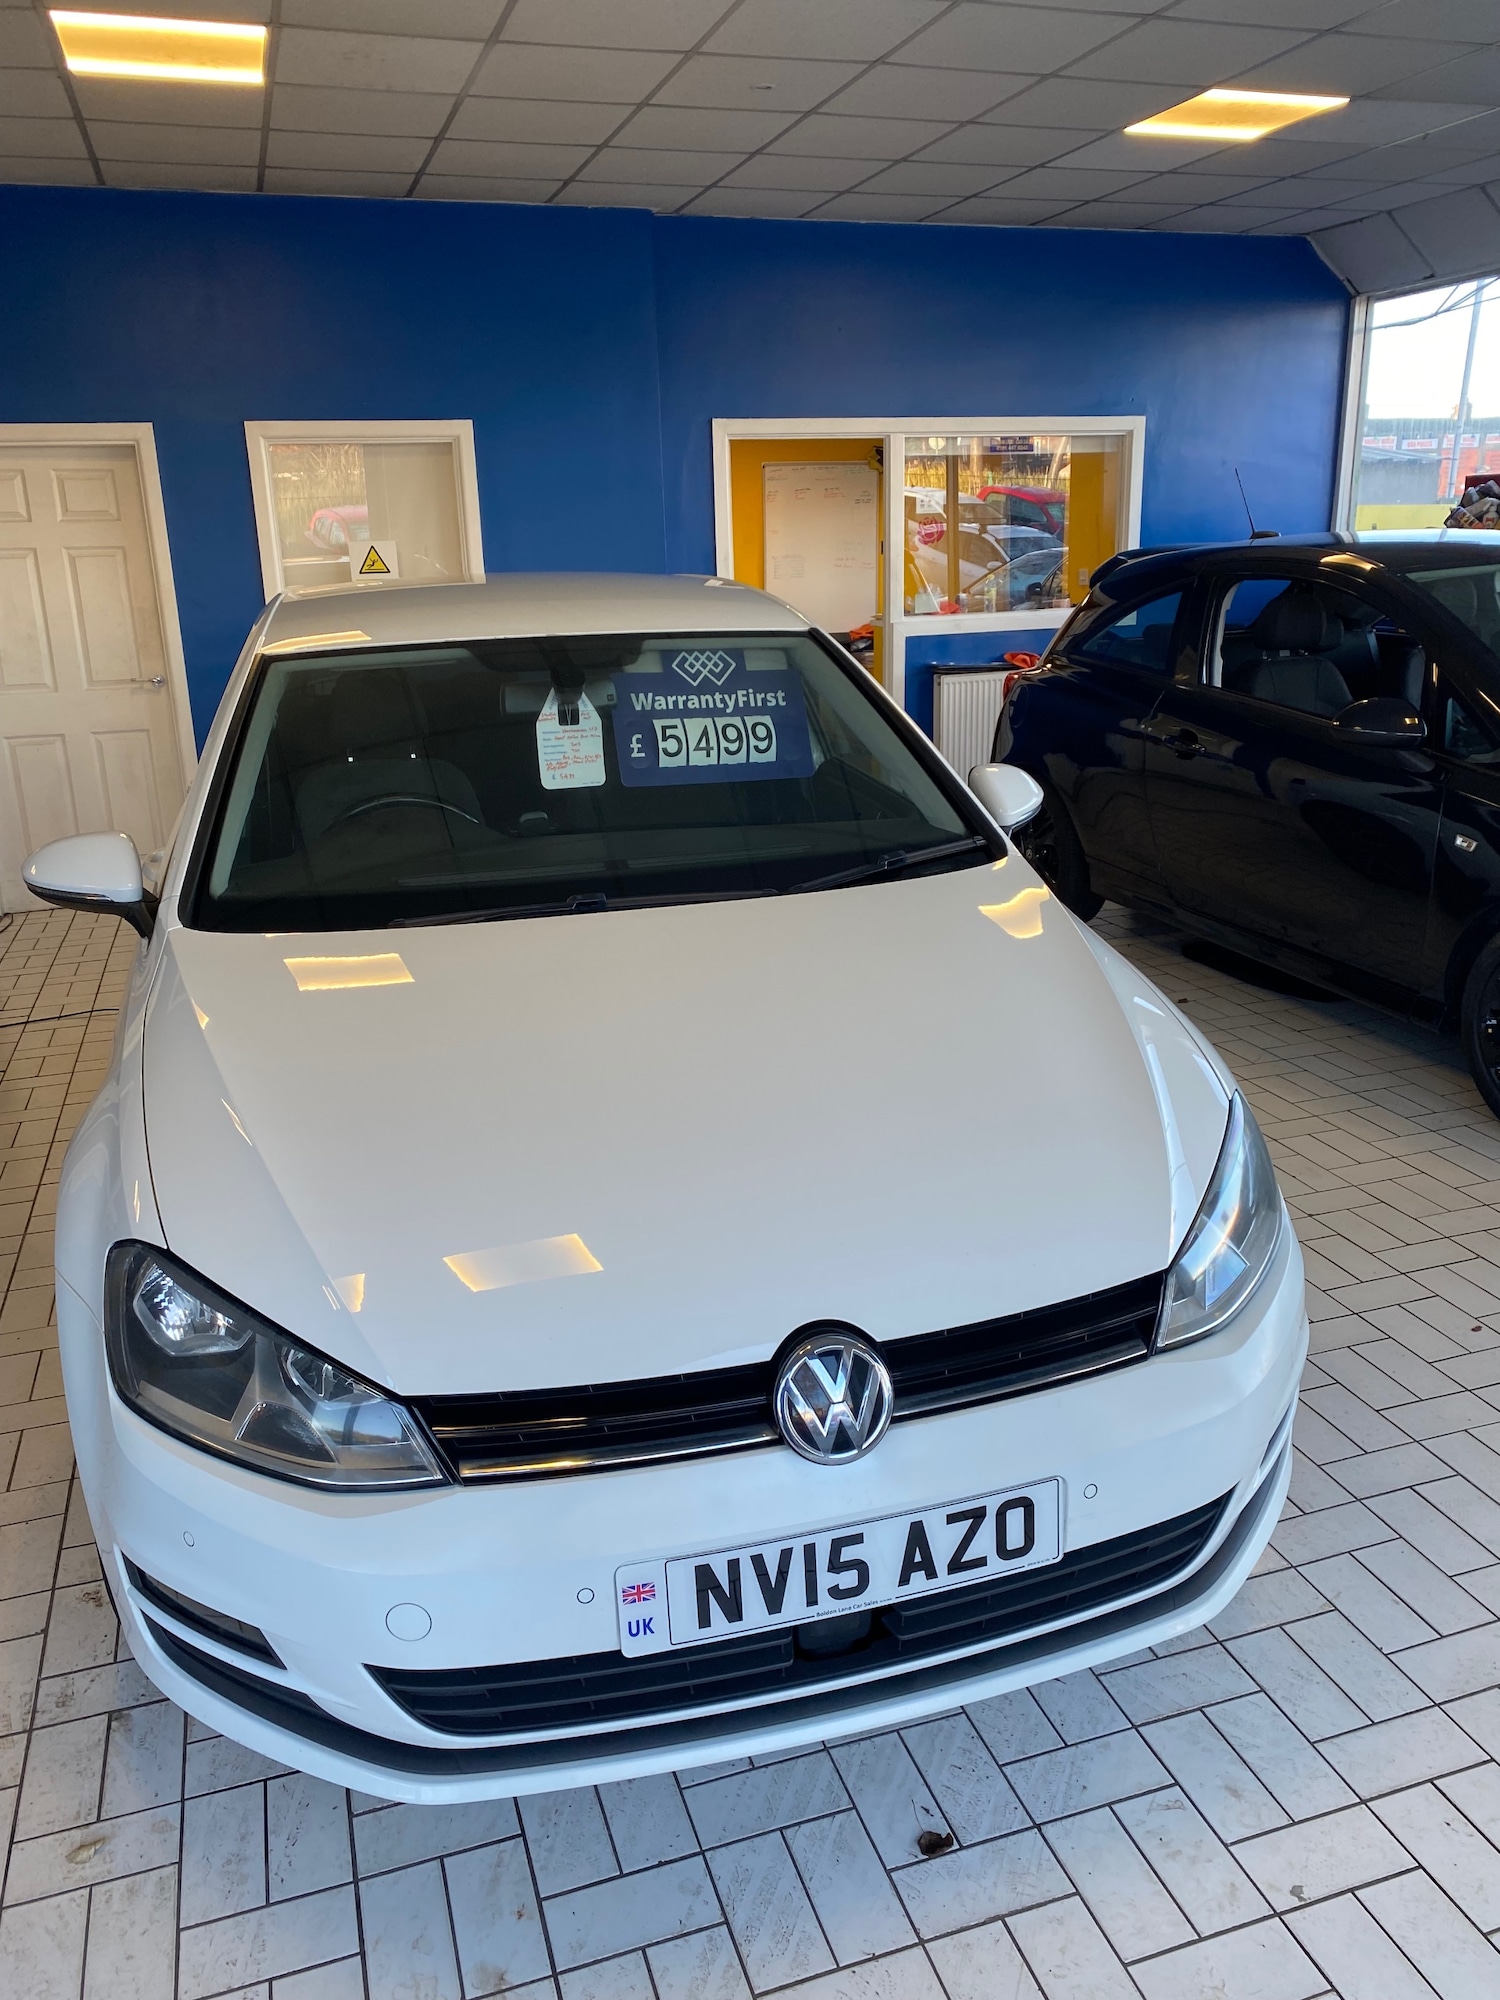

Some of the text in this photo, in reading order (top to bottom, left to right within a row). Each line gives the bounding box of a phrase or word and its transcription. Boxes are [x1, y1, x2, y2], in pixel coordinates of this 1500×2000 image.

[630, 688, 787, 714] WarrantyFirst
[629, 721, 774, 758] £ 5499
[693, 1495, 1036, 1630] NV15 AZO
[627, 1617, 656, 1638] UK
